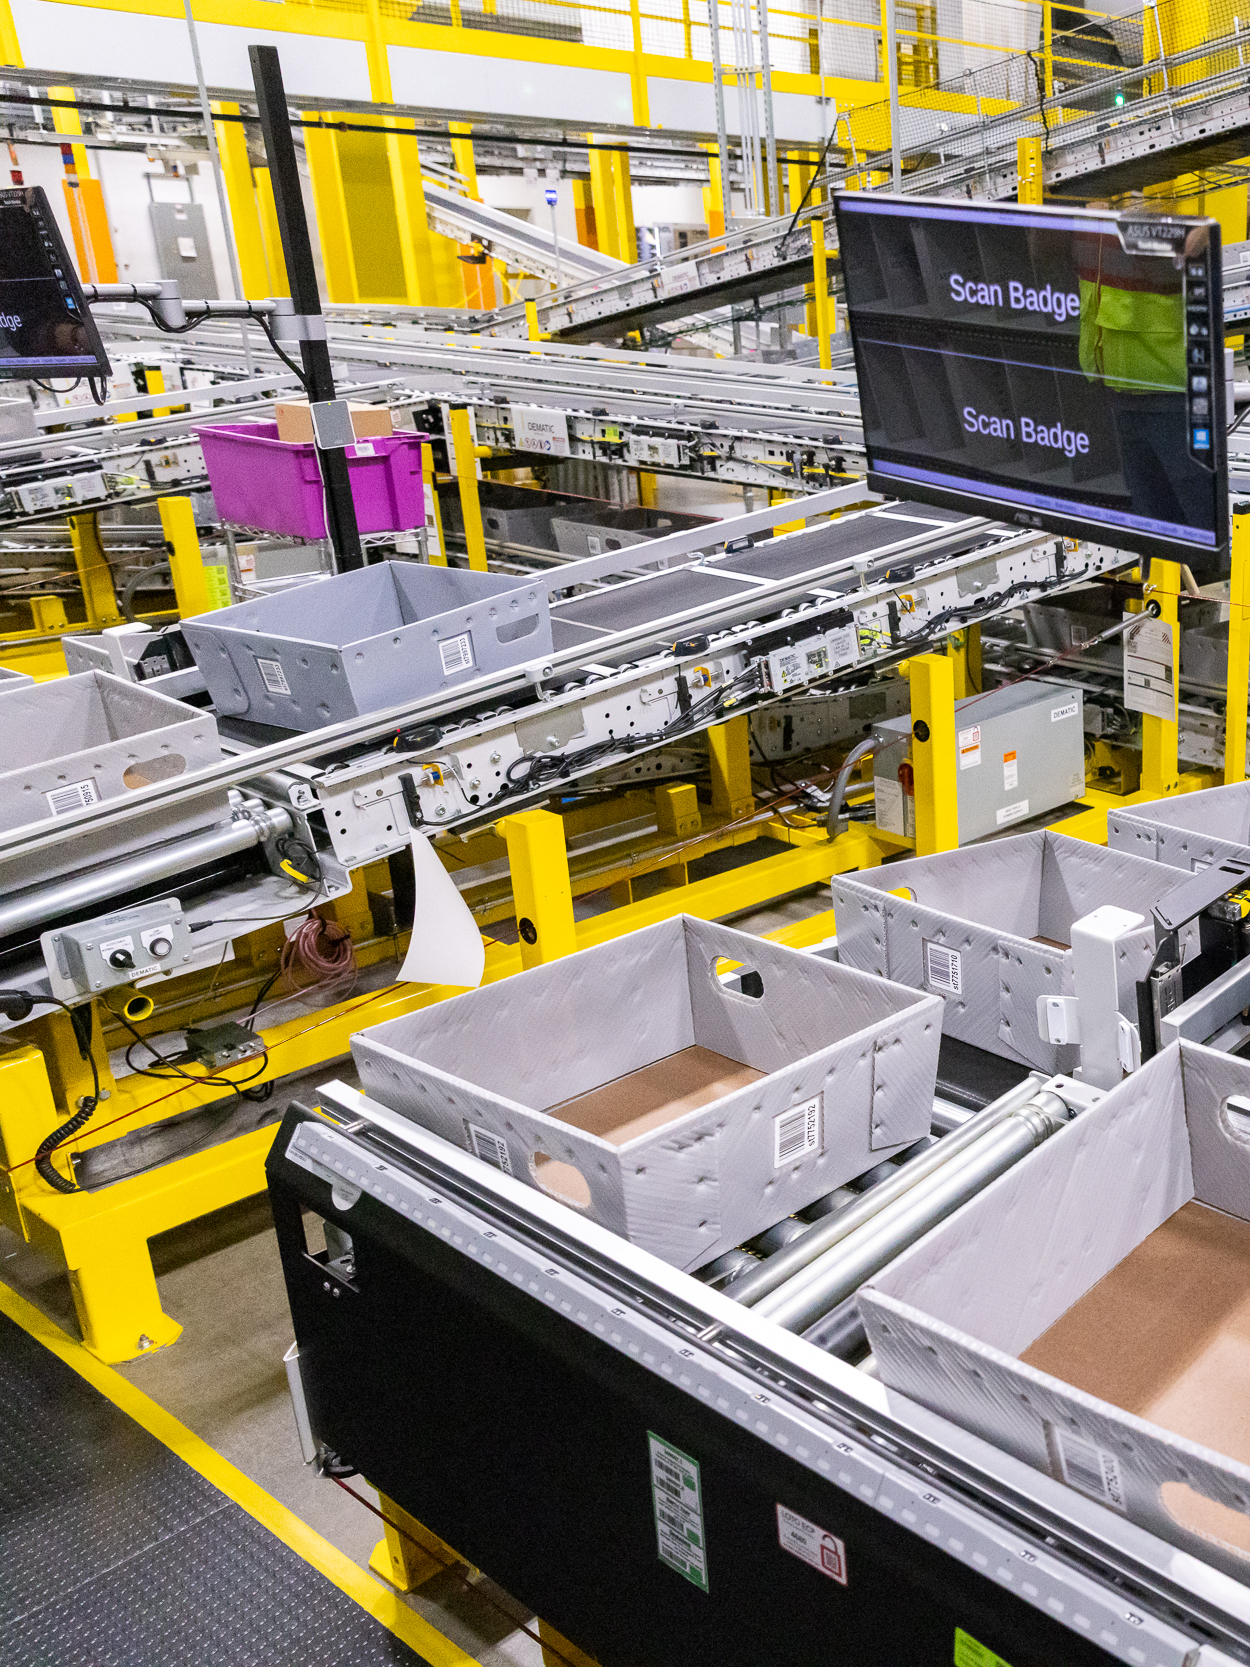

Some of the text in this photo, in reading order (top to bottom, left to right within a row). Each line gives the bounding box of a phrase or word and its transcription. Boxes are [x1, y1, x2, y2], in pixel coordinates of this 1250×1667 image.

[950, 273, 1081, 321] Scan Badge
[0, 312, 23, 332] dge
[527, 421, 555, 434] DEMATIC
[963, 406, 1090, 457] Scan Badge
[1053, 706, 1076, 719] DEMATIC
[131, 965, 158, 979] DEMATIC
[951, 955, 959, 991] st7751710
[807, 1104, 816, 1147] st7752192
[781, 1509, 801, 1527] LOTO
